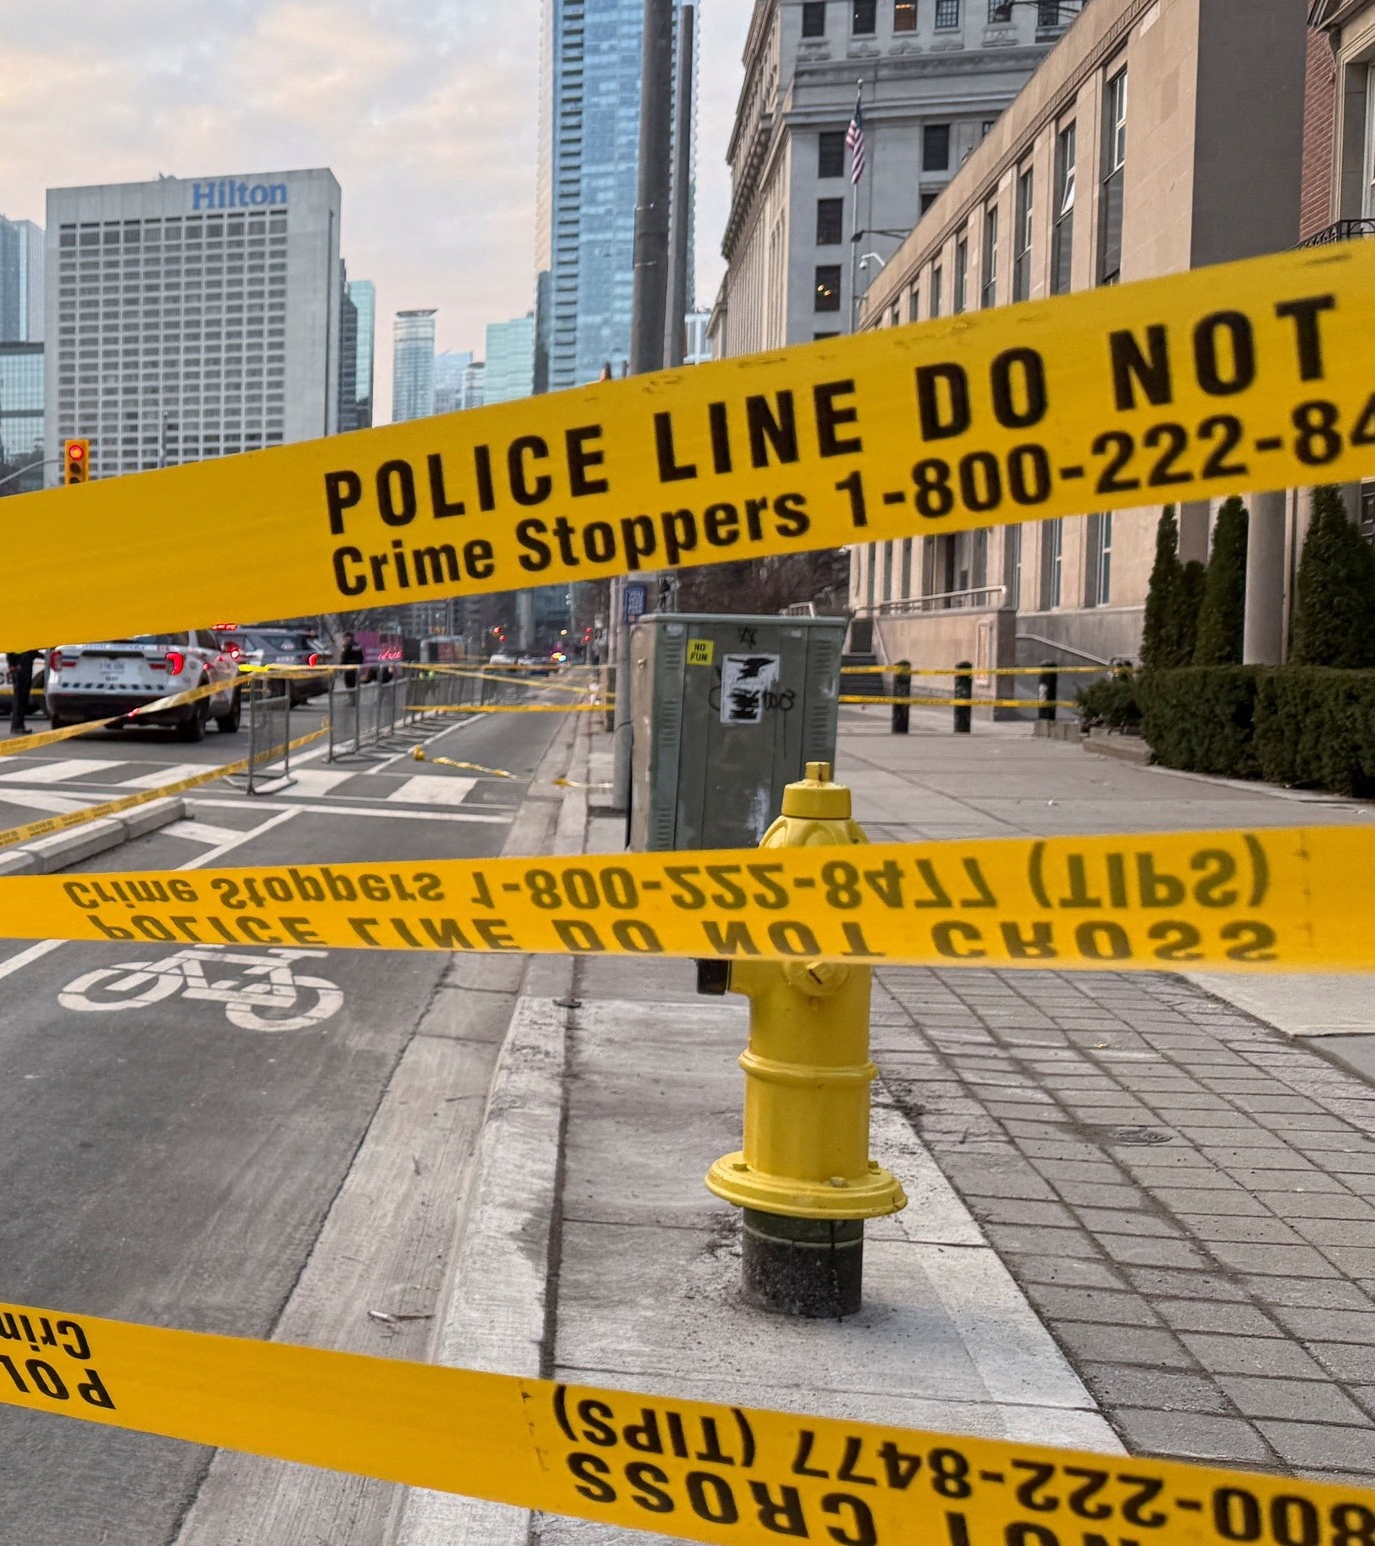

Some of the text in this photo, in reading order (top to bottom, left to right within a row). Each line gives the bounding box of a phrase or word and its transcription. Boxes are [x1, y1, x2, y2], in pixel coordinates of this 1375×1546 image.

[191, 180, 288, 211] Hilton
[324, 292, 1337, 536] POLICE LINE DO NOT
[332, 538, 496, 597] Crime
[515, 491, 812, 571] Stoppers
[694, 642, 706, 652] NO
[552, 1384, 756, 1467] (TIPS)
[566, 1451, 877, 1546] CROSS
